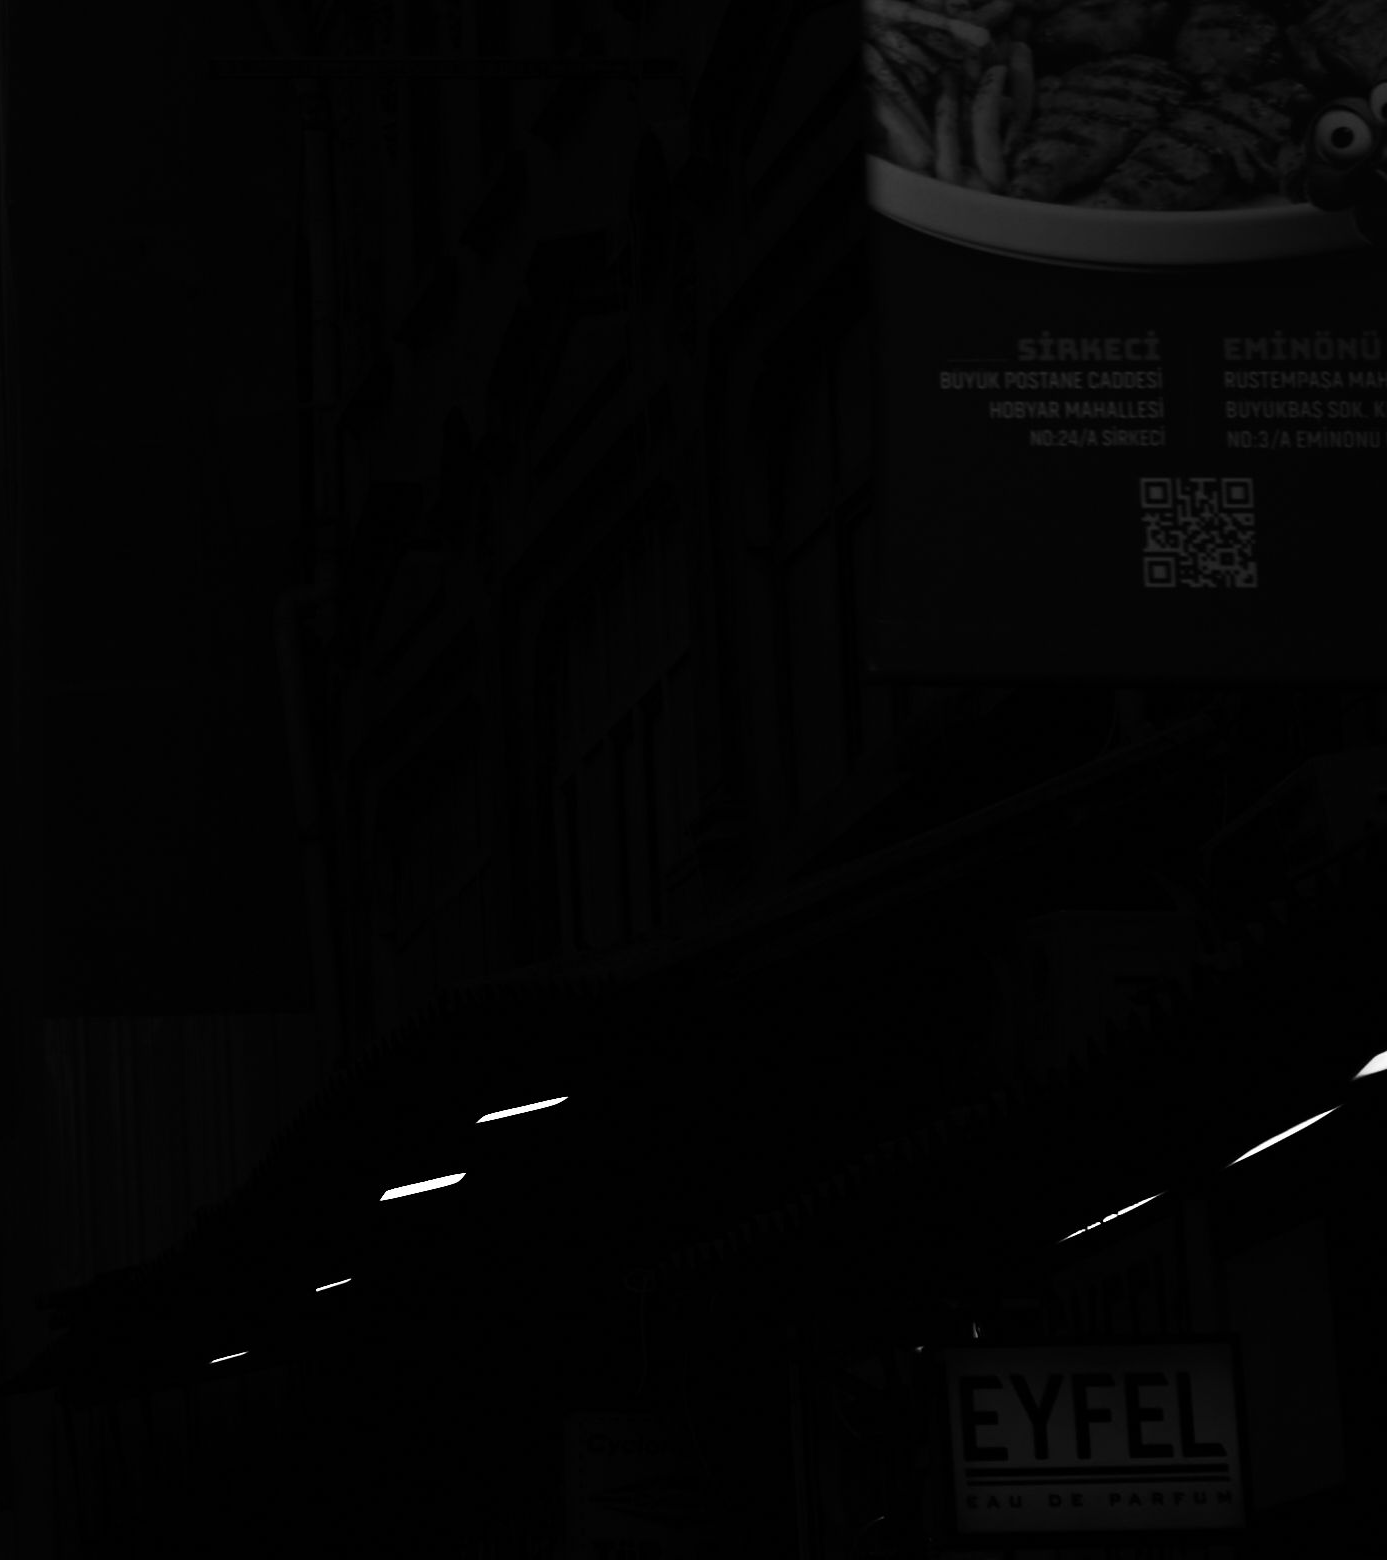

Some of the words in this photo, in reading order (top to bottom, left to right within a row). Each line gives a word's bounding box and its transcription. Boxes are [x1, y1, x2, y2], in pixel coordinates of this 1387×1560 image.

[1017, 330, 1162, 362] SİRKECİ
[1222, 330, 1382, 361] EMİNÖNÜ
[1004, 370, 1084, 390] POSTANE
[1087, 367, 1164, 390] CADDESİ
[988, 400, 1060, 419] HOBYAR
[1064, 397, 1165, 419] MAHALLESİ
[1029, 428, 1098, 447] NO:24/A
[1101, 426, 1167, 446] SİRKECİ
[1226, 429, 1292, 450] NO:3/A
[959, 1371, 1227, 1461] EYFEL
[965, 1494, 1023, 1509] EAU
[1049, 1493, 1085, 1508] DE
[1109, 1490, 1234, 1507] PARFUM
